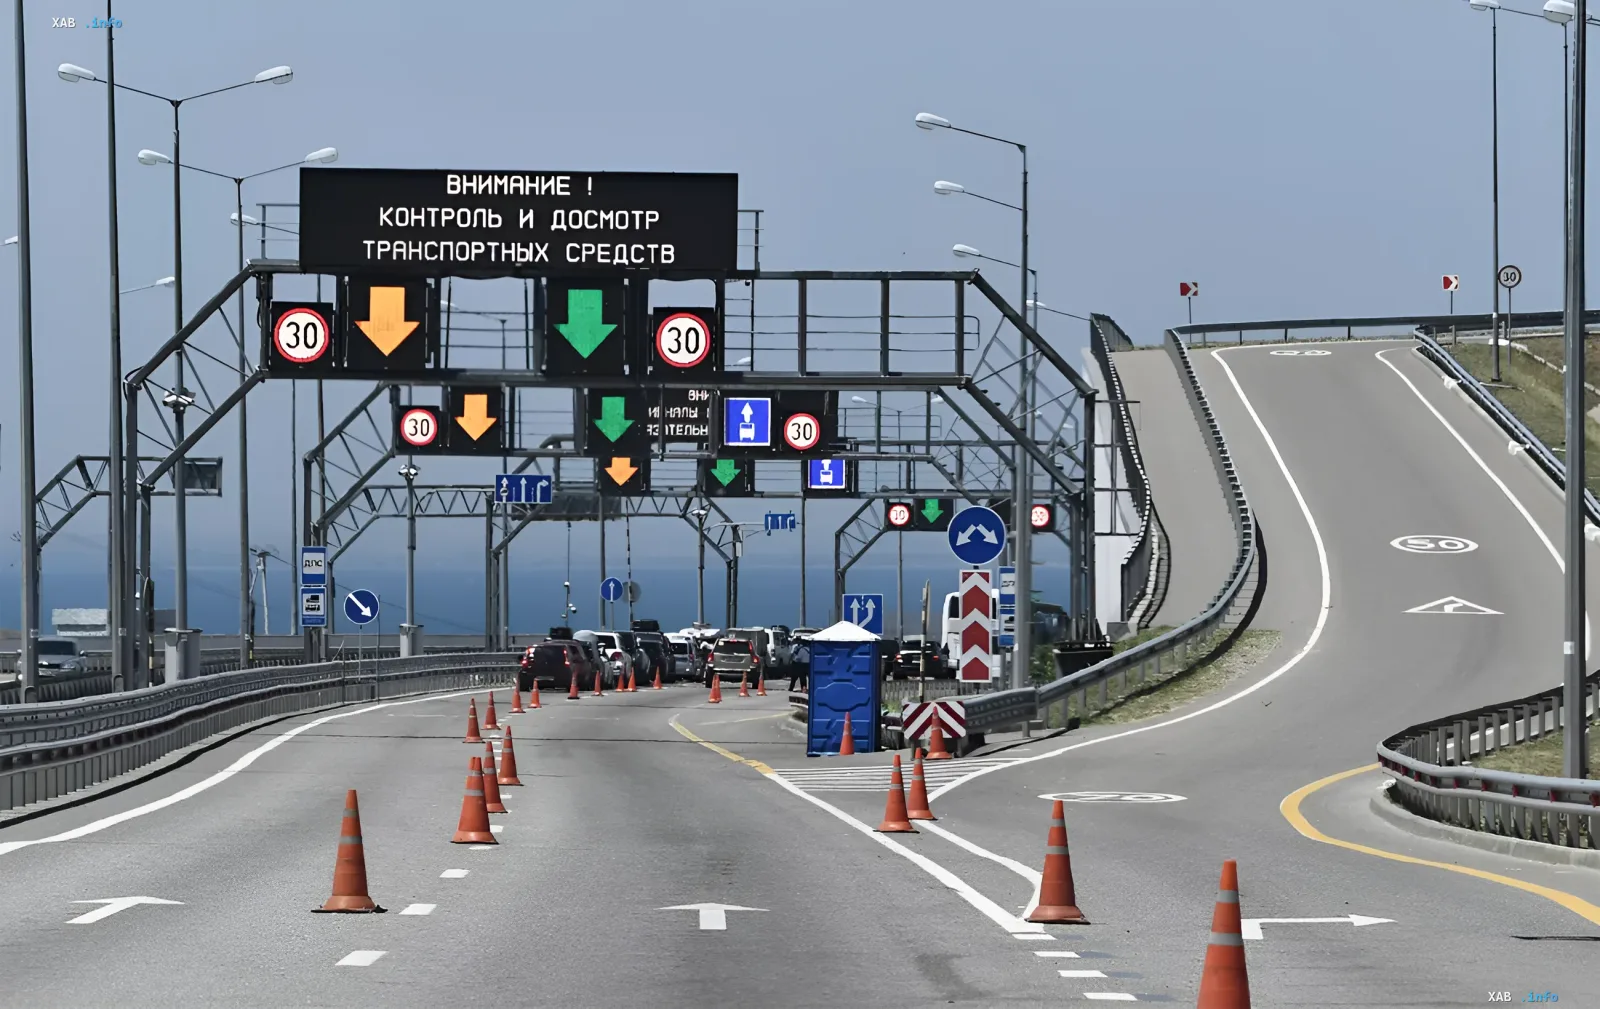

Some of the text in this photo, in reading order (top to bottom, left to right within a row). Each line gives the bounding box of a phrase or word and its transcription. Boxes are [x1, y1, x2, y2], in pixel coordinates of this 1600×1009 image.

[447, 174, 593, 196] ВНИМАНИЕ !
[380, 207, 659, 231] КОНТРОЛЬ И ДОСМОТР
[363, 240, 674, 265] ТРАНСПОРТНЫХ СРЕДСТВ
[286, 321, 318, 349] 30
[667, 326, 700, 354] 30
[408, 418, 430, 437] 30
[791, 422, 813, 441] 30
[1406, 539, 1465, 550] 50
[304, 559, 323, 568] ДПС
